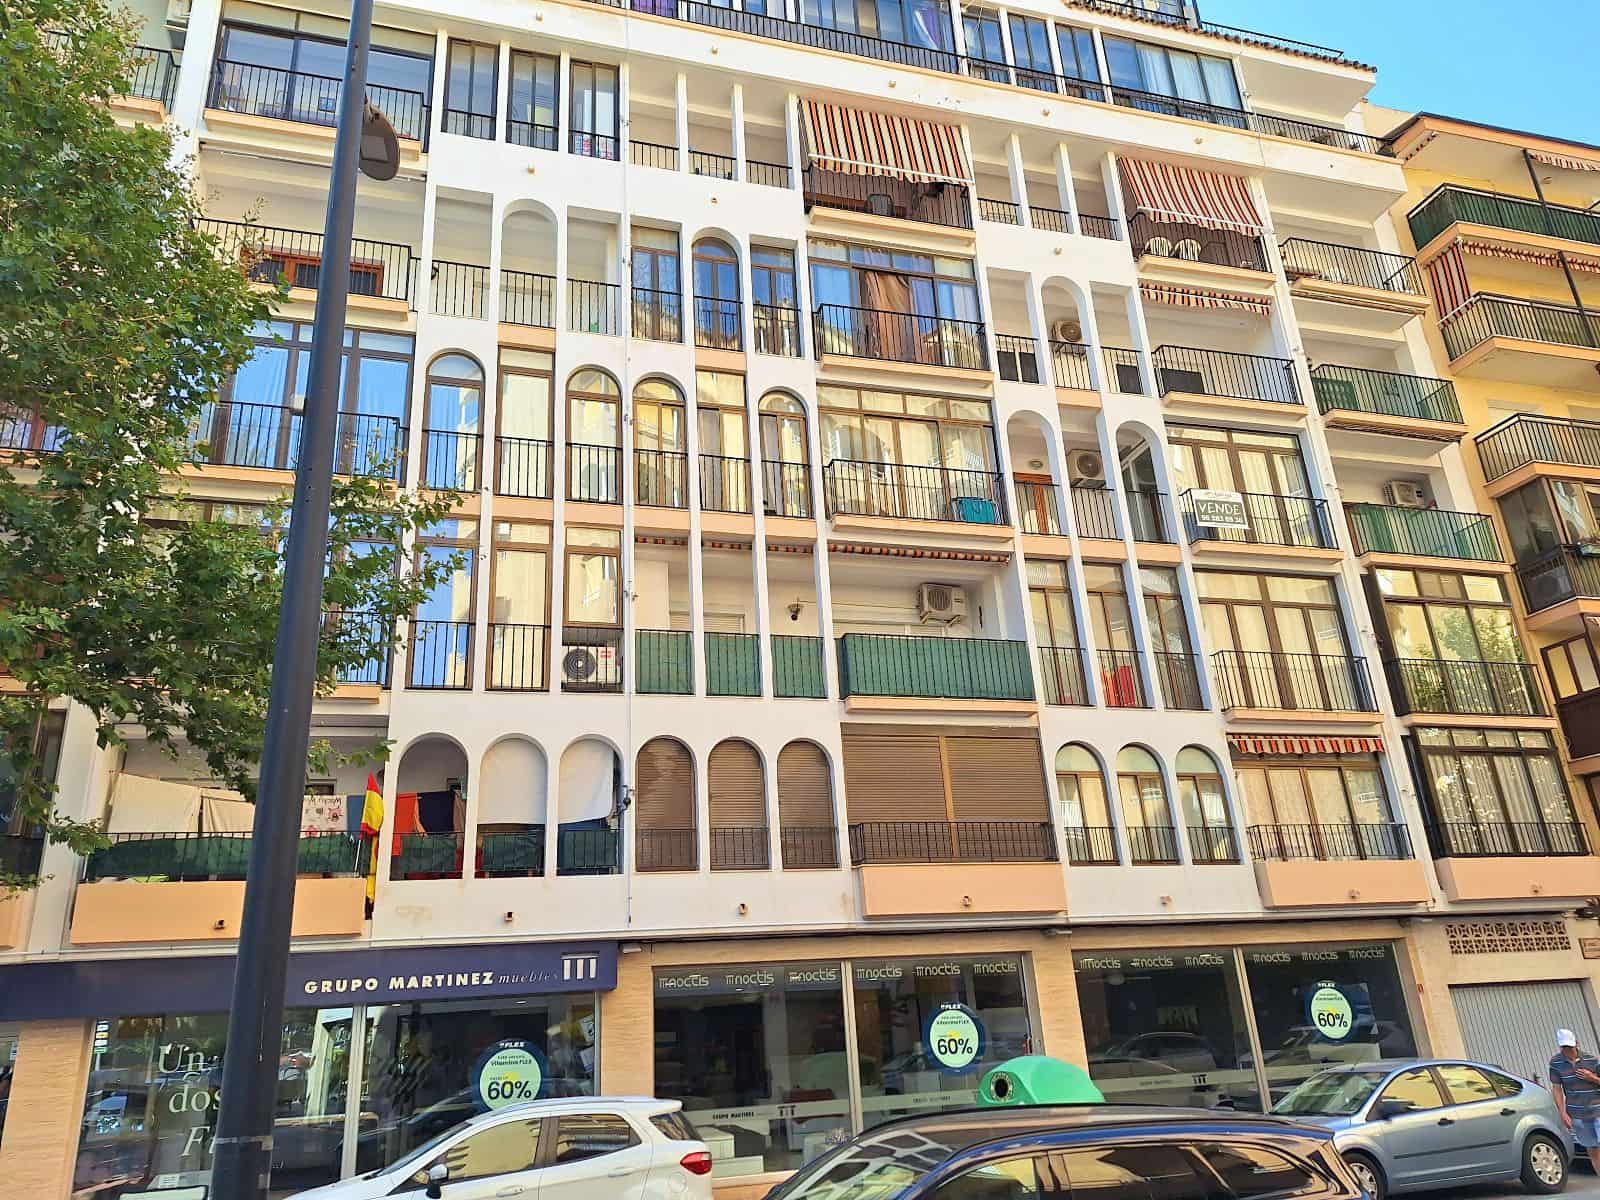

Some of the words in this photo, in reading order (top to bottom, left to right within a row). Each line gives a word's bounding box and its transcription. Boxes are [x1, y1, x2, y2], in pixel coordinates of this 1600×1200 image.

[1198, 502, 1241, 514] VENDE
[304, 978, 379, 994] GRUPO
[388, 971, 494, 990] MARTINEZ
[1318, 1012, 1348, 1028] 60%
[937, 1038, 973, 1055] 60%
[487, 1080, 532, 1100] 60%
